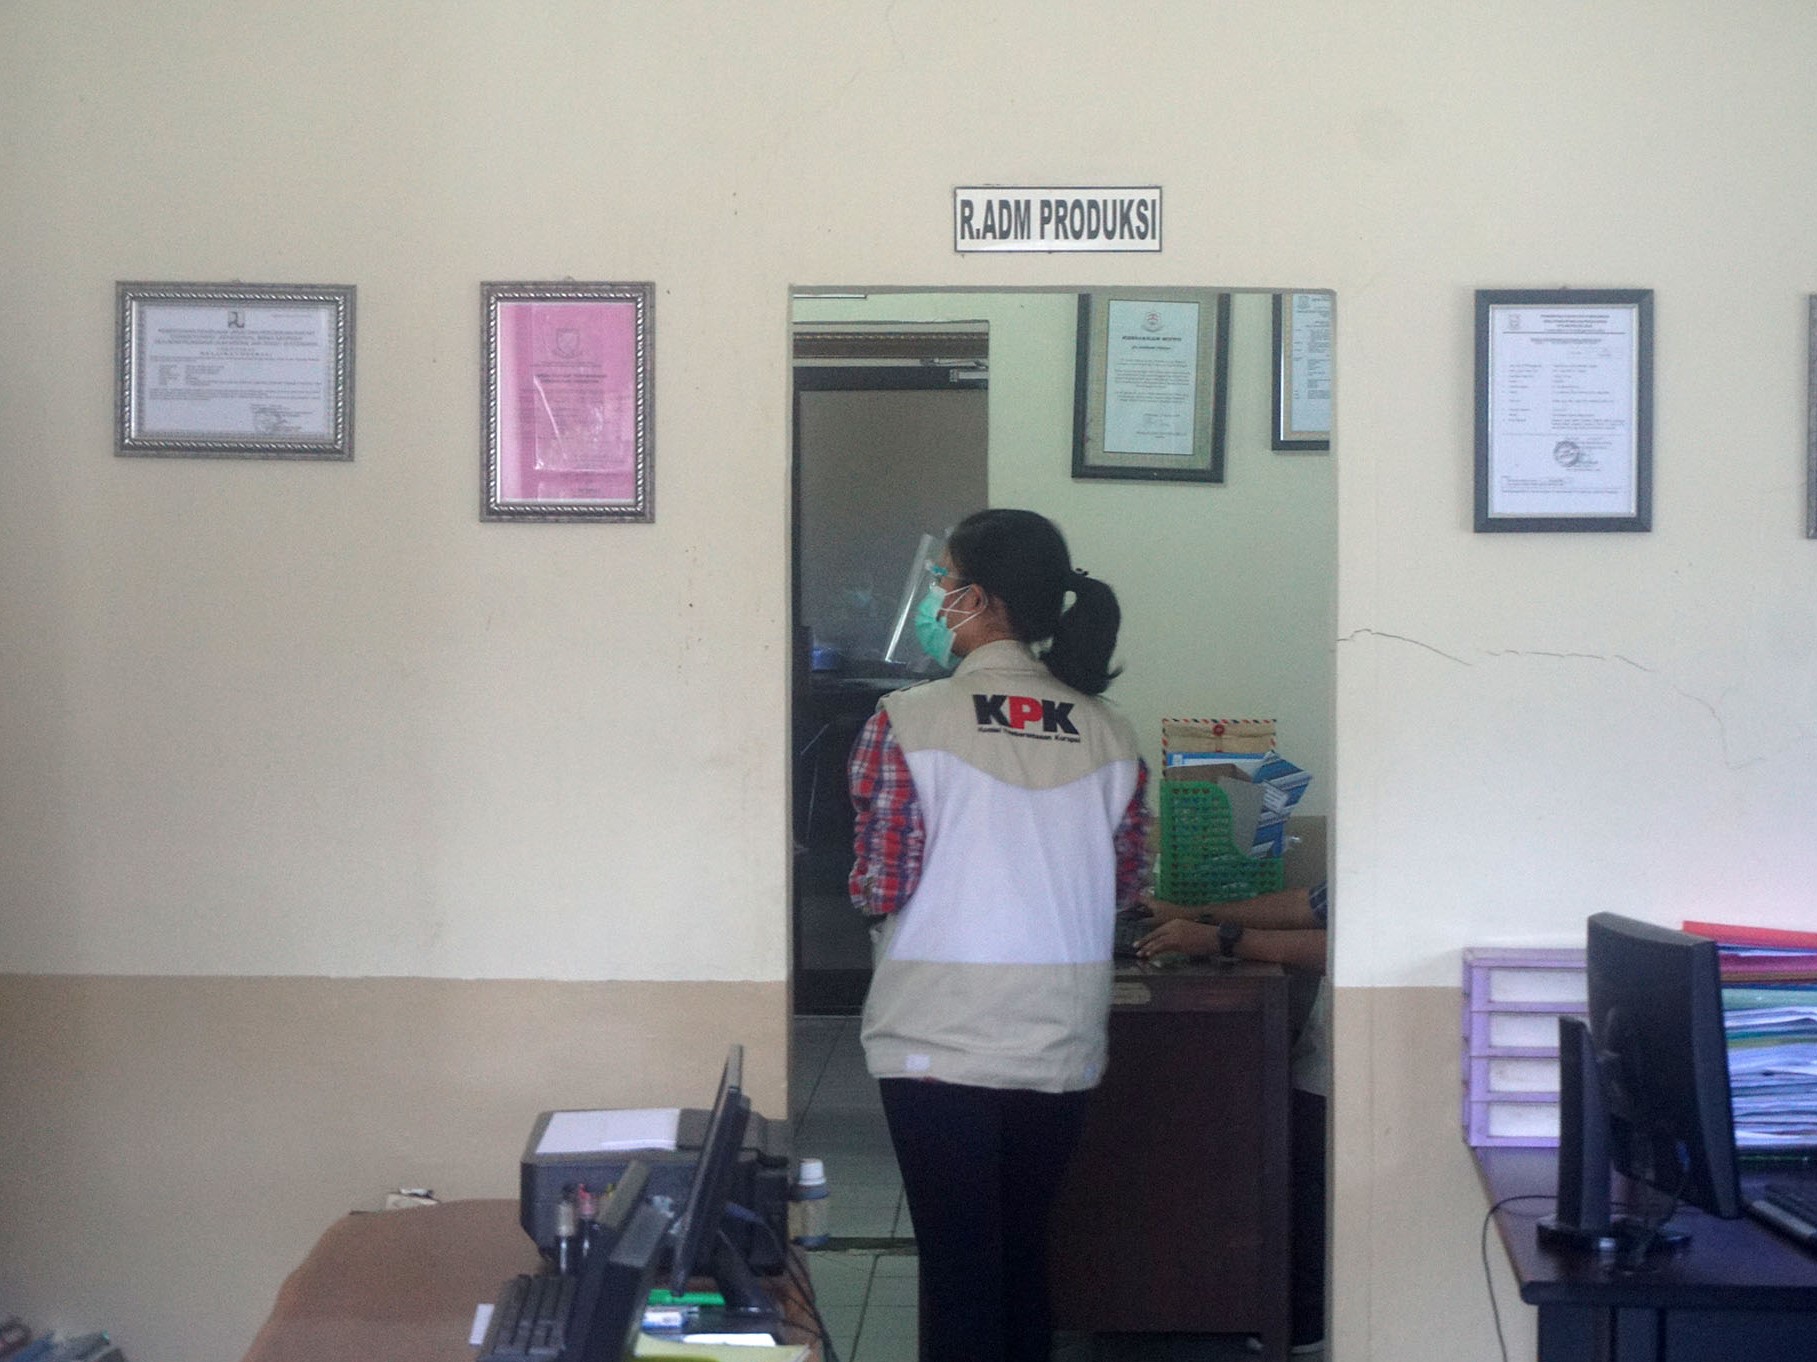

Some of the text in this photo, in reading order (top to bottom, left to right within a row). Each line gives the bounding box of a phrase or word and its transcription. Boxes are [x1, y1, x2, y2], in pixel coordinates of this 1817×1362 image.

[960, 198, 1157, 240] R.ADM PRODUKSI
[972, 694, 1080, 735] KPK
